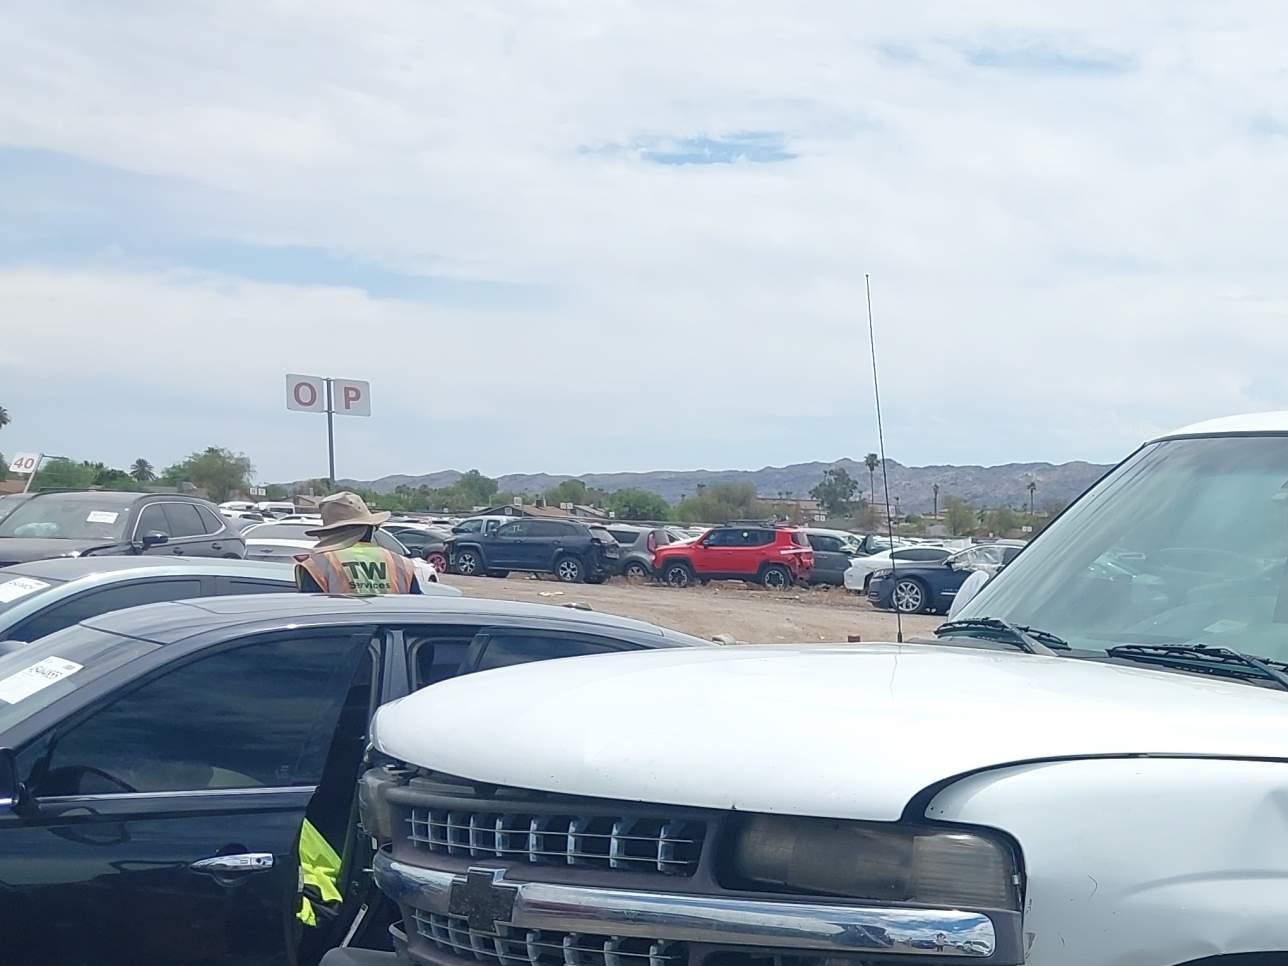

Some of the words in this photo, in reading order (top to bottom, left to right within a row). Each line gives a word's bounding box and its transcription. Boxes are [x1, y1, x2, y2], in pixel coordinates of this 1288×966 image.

[294, 382, 317, 407] O
[343, 386, 361, 409] P
[13, 456, 35, 469] 40
[342, 561, 387, 580] TW
